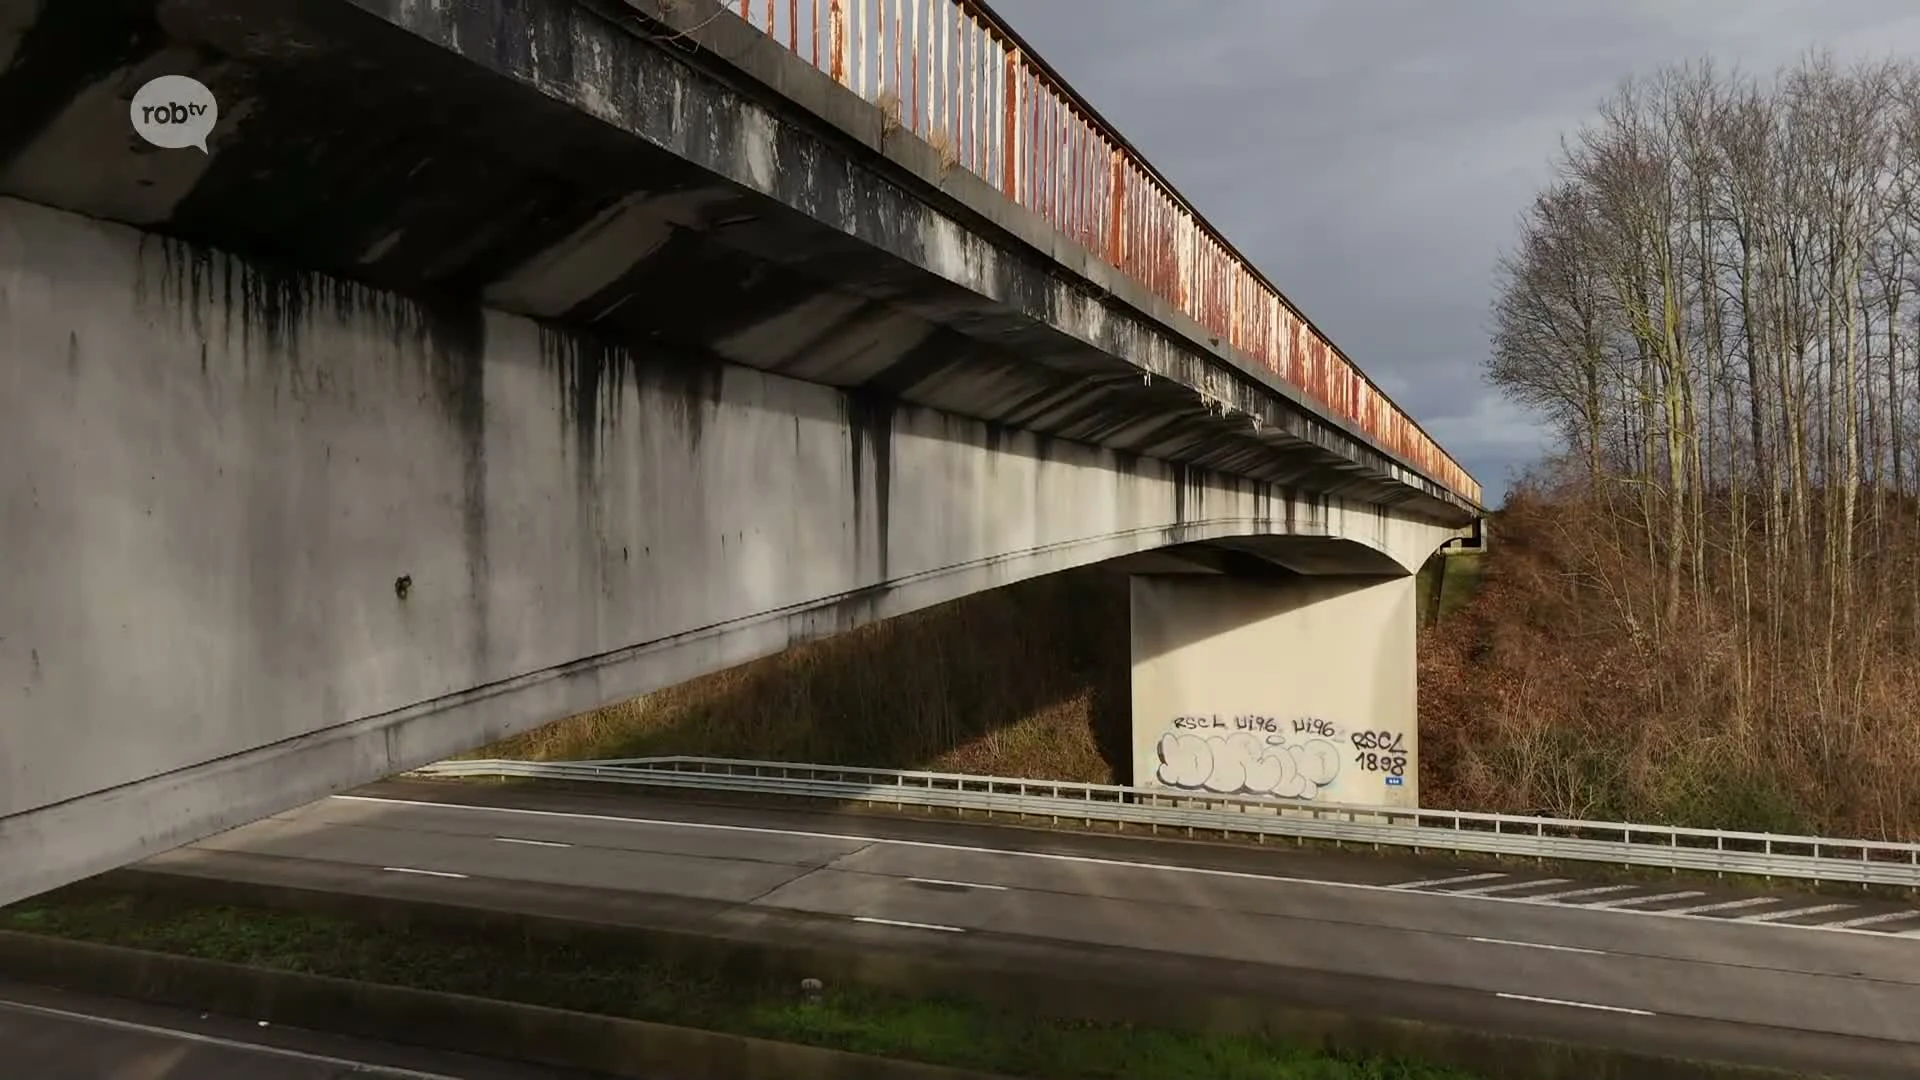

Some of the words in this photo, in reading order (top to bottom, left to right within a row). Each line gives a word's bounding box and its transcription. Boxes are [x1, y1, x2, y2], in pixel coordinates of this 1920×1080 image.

[1174, 714, 1225, 730] RSCL
[1351, 731, 1408, 753] RSCL
[1355, 751, 1407, 776] 1898
